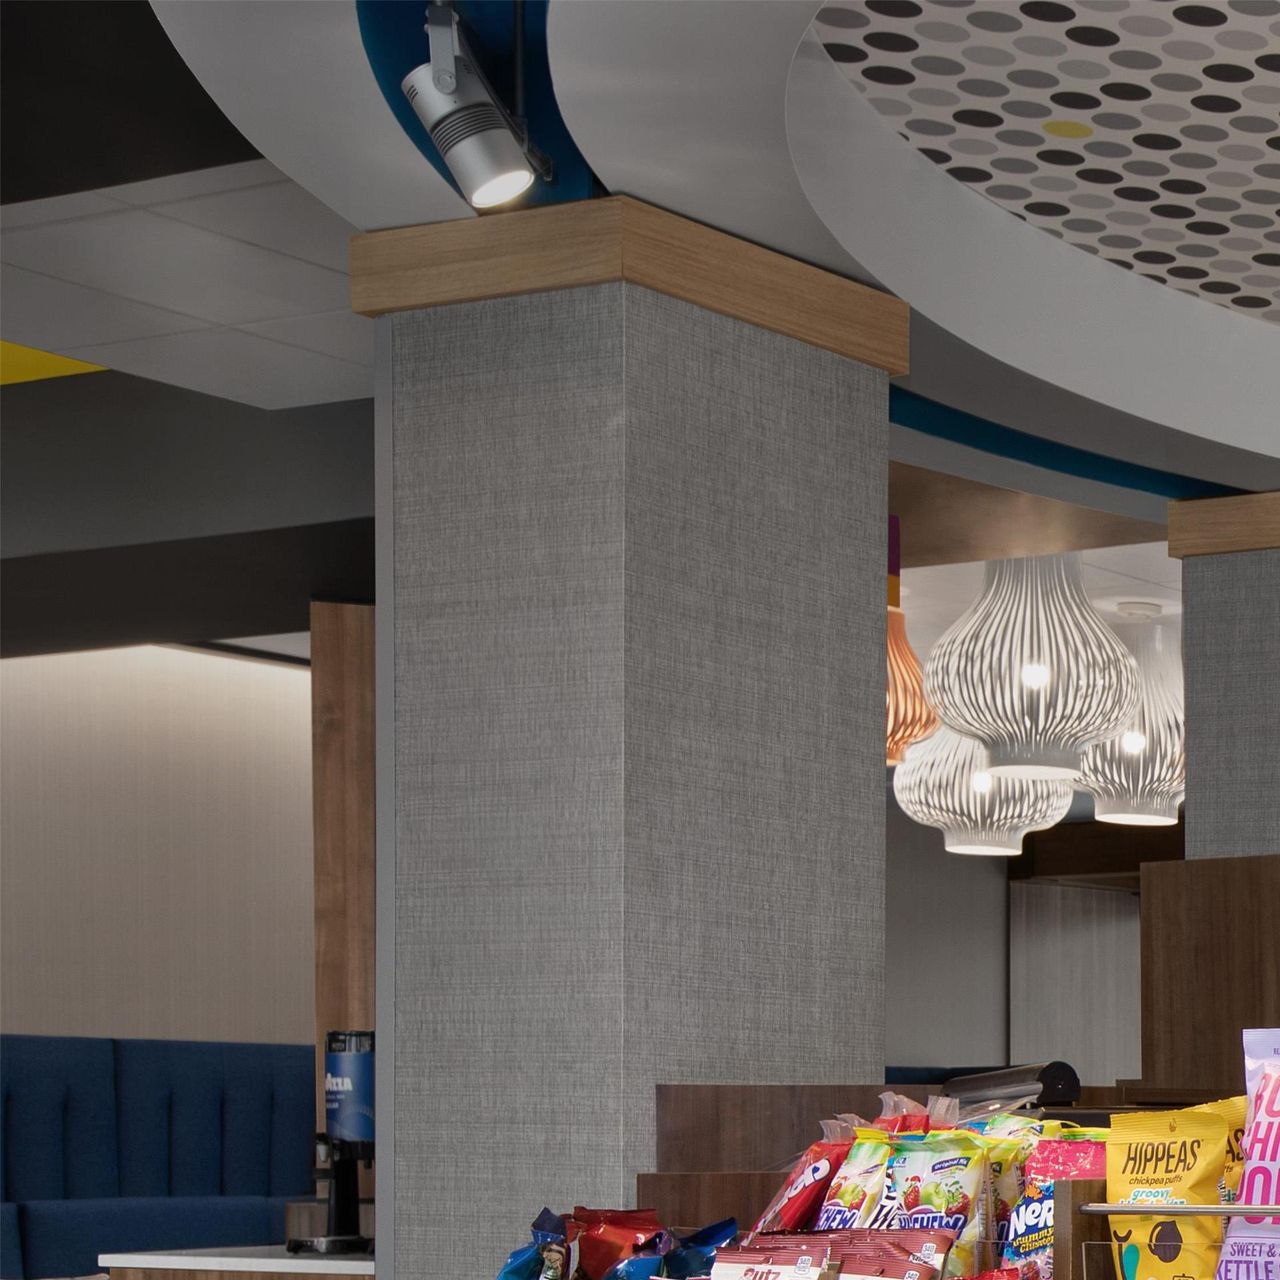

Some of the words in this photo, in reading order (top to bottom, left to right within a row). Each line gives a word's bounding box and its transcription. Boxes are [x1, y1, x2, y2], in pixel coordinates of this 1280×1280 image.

[1122, 1139, 1200, 1175] HIPPEAS
[1129, 1177, 1164, 1186] chickpea
[1164, 1175, 1182, 1186] puffs
[1231, 1242, 1265, 1257] SWEET
[1266, 1243, 1276, 1258] &
